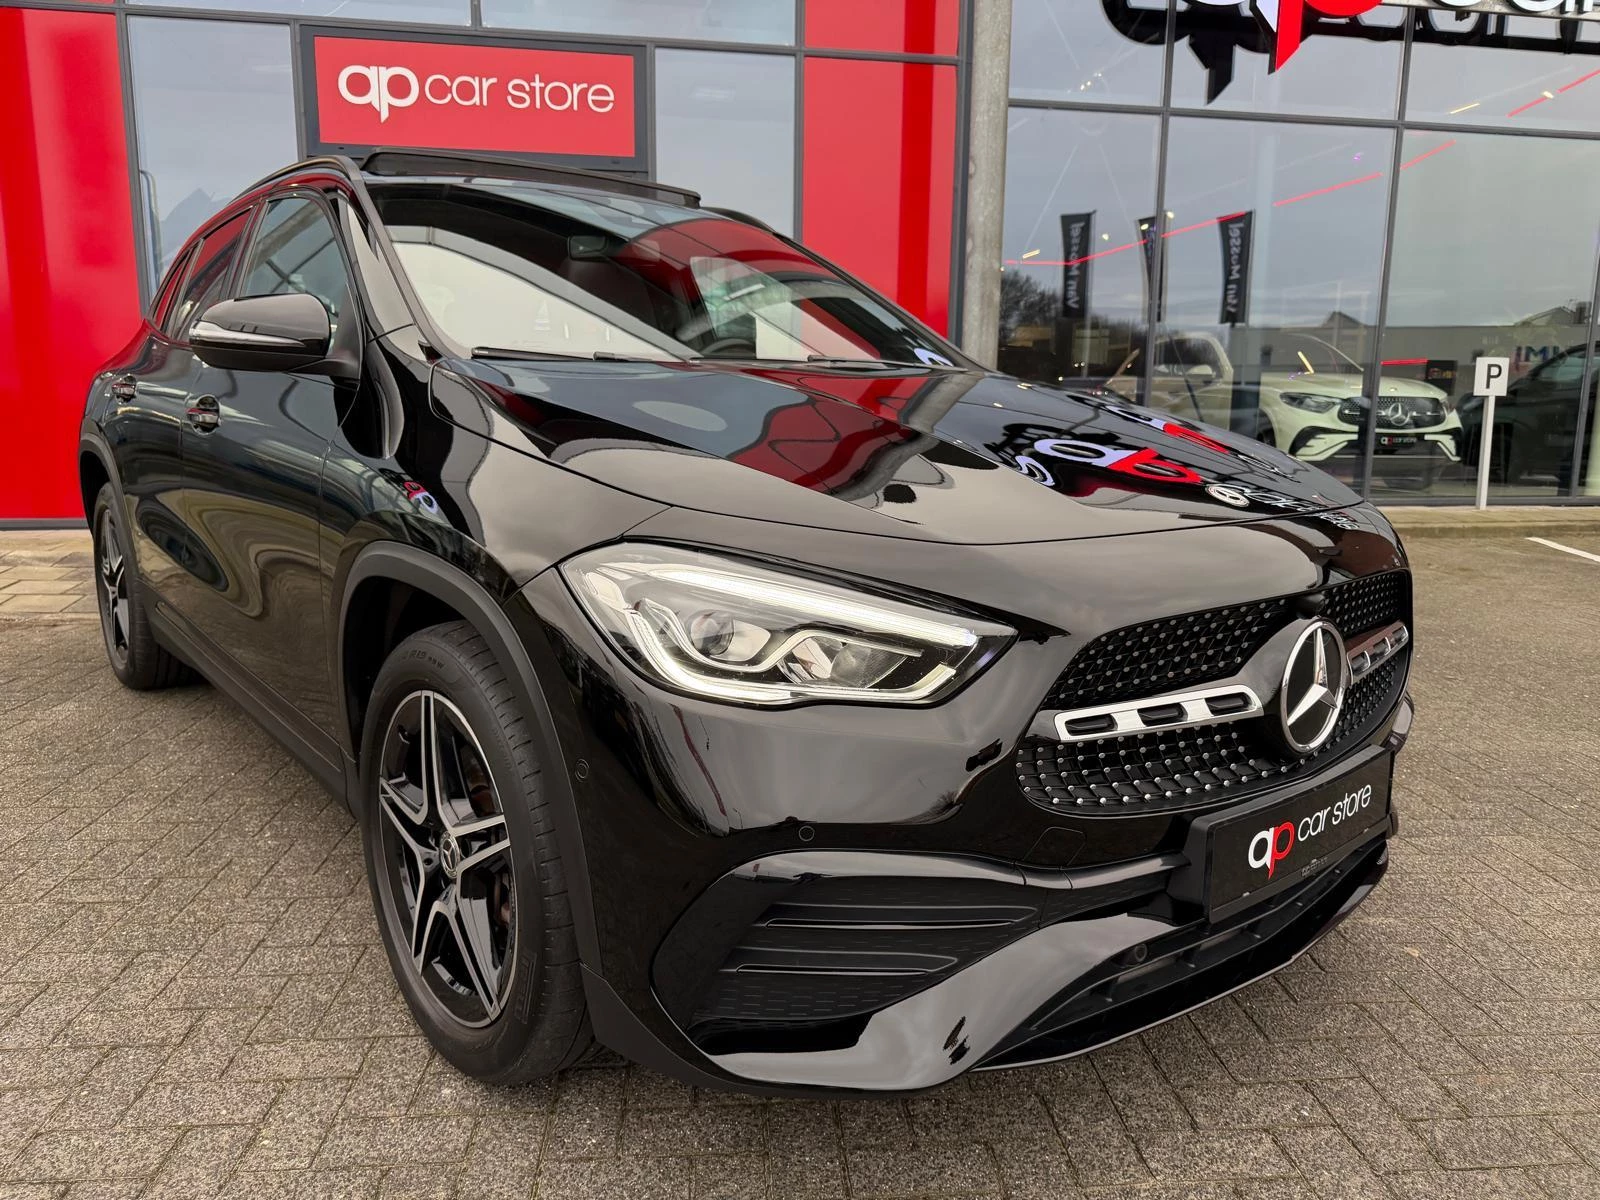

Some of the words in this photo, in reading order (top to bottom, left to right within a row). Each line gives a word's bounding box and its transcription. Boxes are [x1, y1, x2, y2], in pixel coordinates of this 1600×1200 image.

[338, 65, 420, 122] ap
[424, 74, 498, 106] car
[506, 73, 615, 113] store
[1485, 363, 1502, 390] P
[1247, 821, 1296, 880] ap
[1297, 807, 1332, 842] car
[1331, 784, 1372, 826] store
